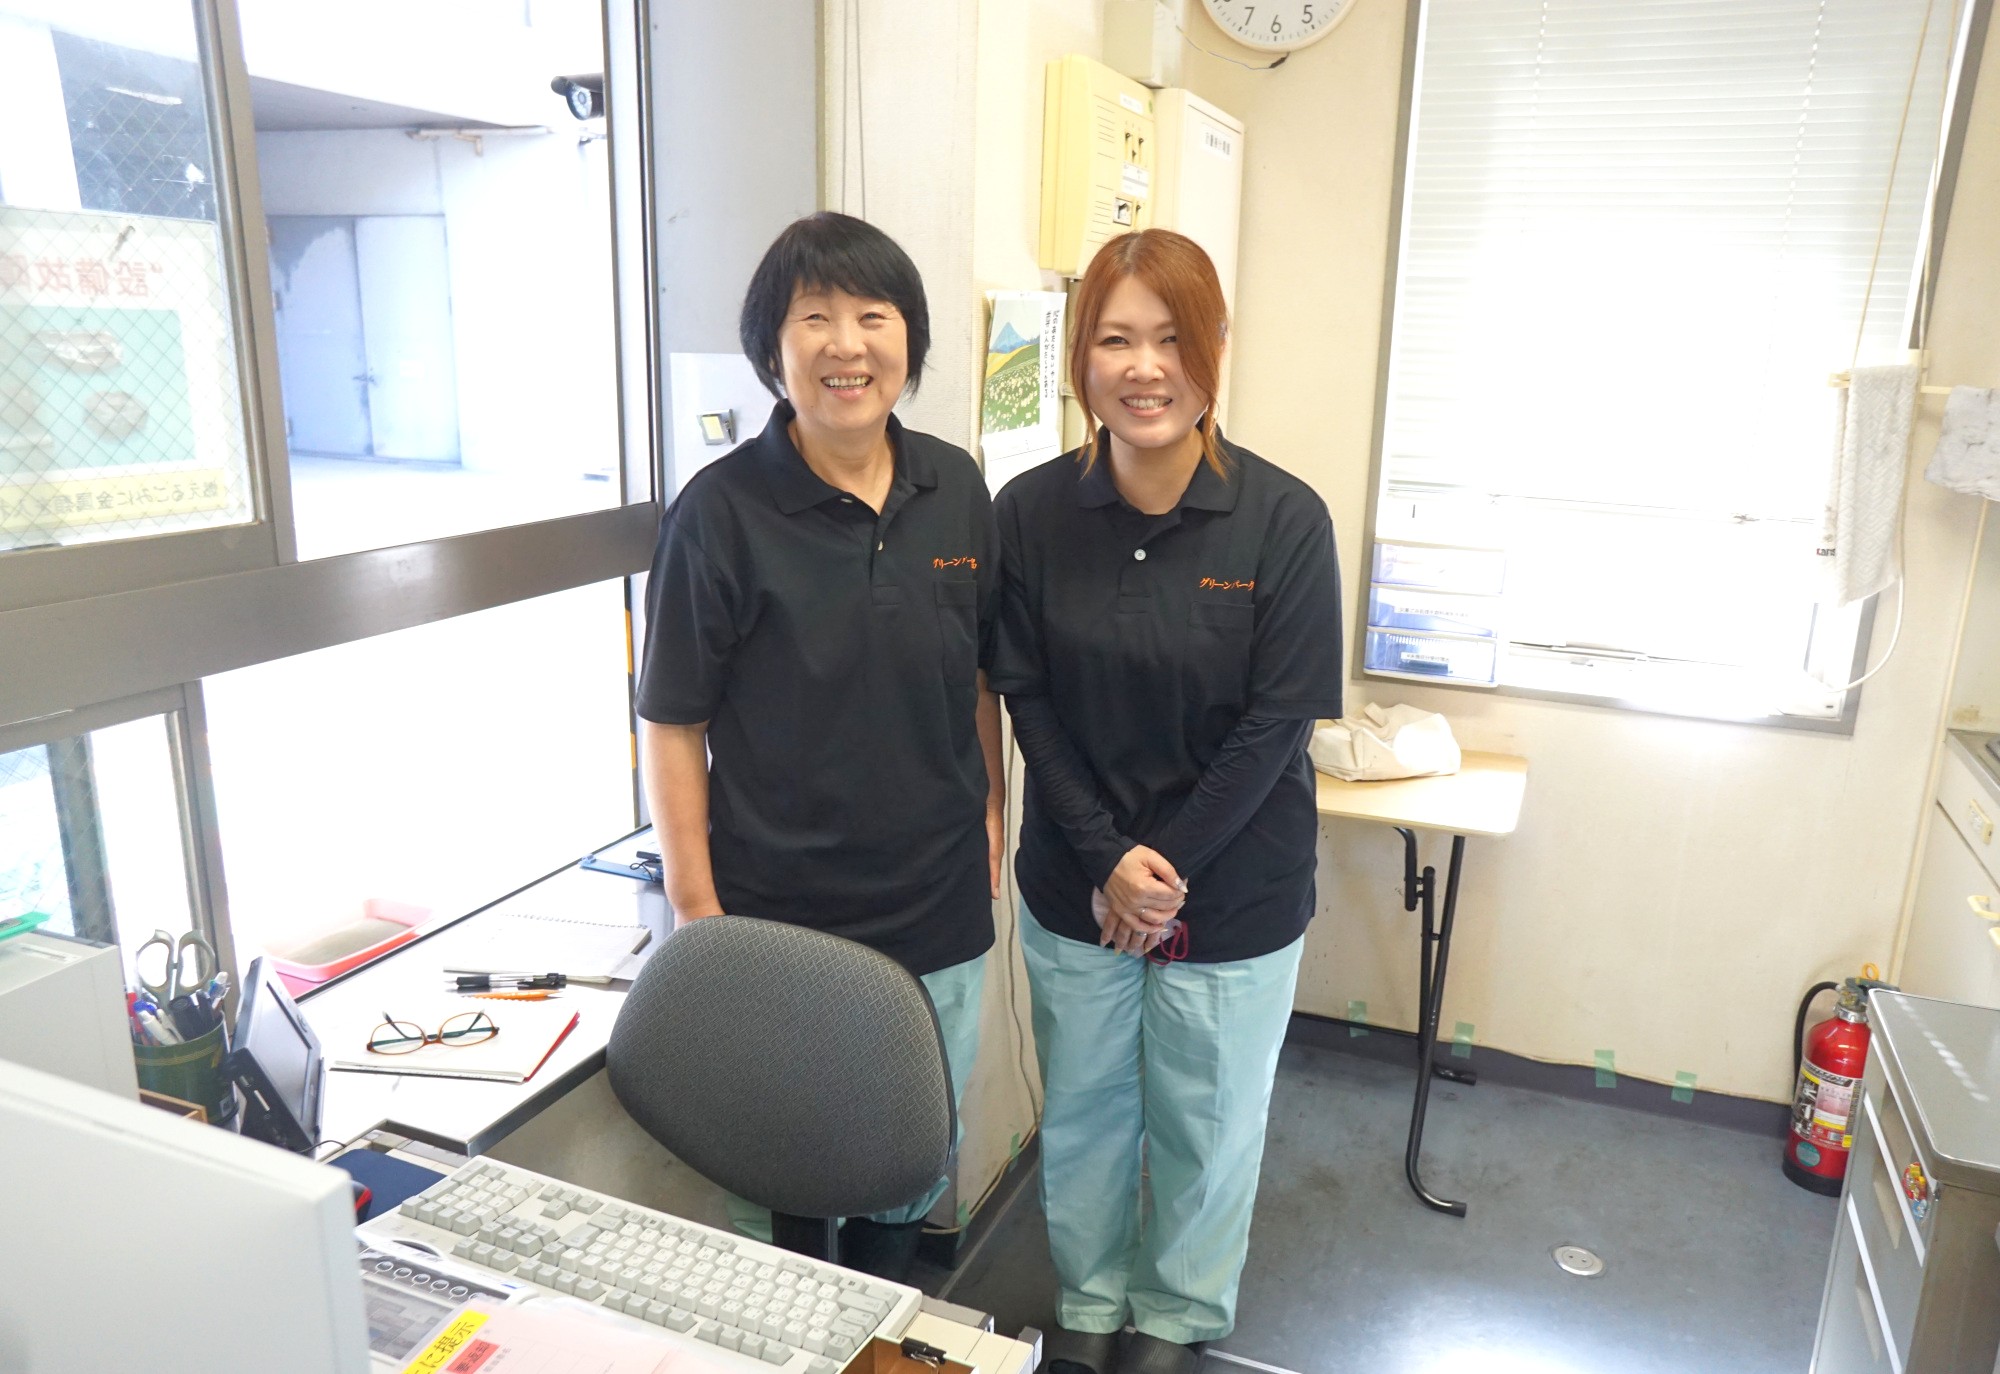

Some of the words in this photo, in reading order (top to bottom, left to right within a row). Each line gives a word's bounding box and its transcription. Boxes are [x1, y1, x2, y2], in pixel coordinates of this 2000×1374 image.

[1244, 6, 1255, 26] 7
[1270, 14, 1282, 34] 6
[1301, 4, 1313, 24] 5
